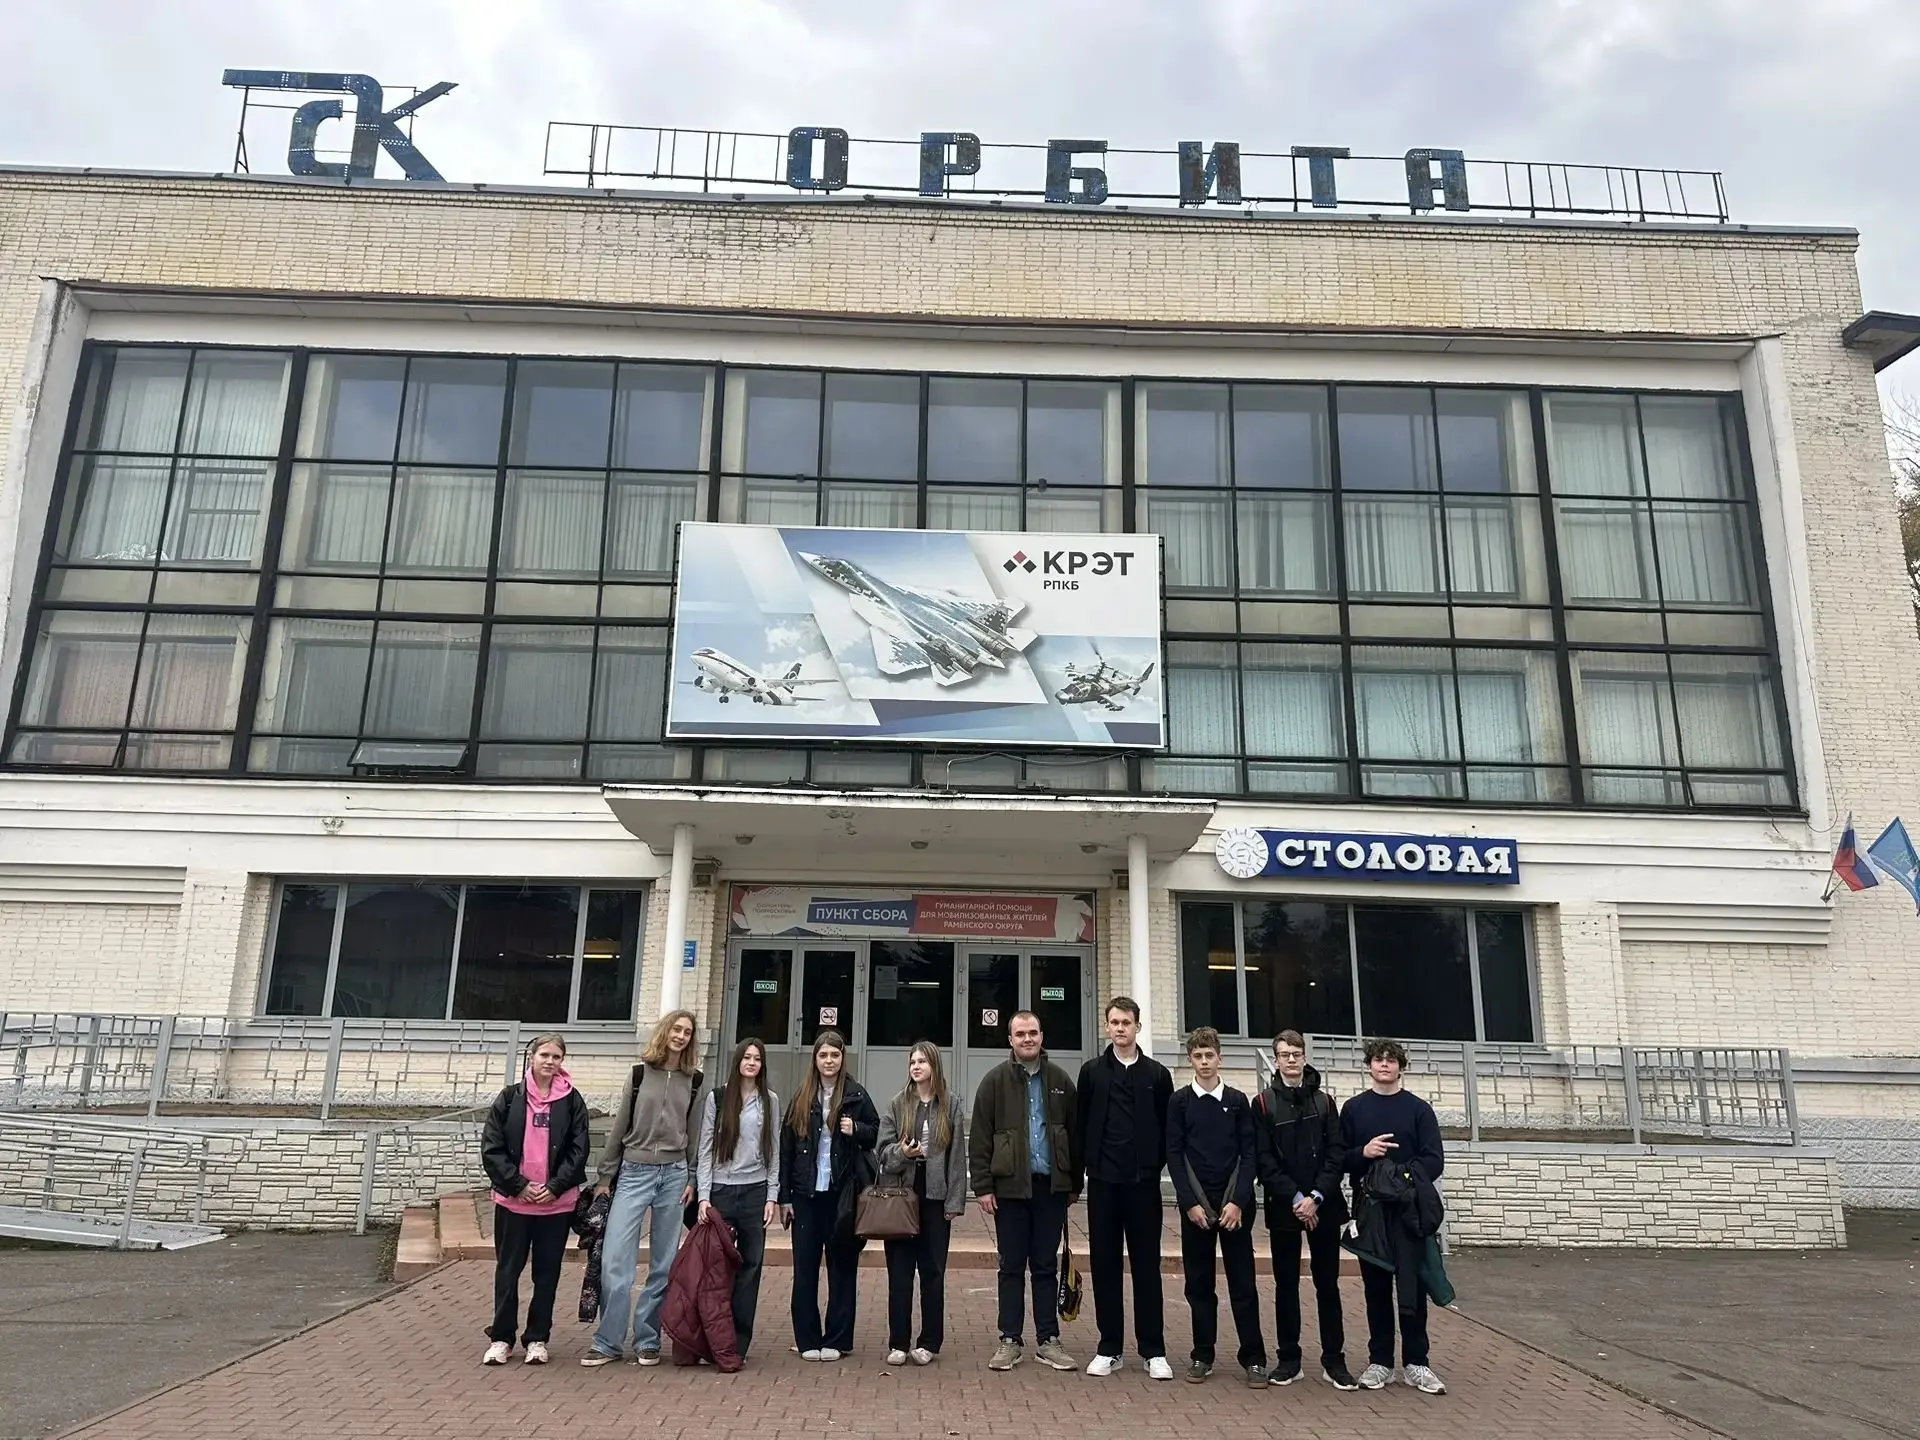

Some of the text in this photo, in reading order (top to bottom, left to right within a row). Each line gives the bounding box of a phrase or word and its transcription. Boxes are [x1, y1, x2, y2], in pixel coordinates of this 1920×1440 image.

[787, 126, 1470, 211] ОРБИТА
[1043, 551, 1135, 576] КРЭТ
[1043, 580, 1079, 590] РПКБ
[1275, 838, 1512, 875] СТОЛОВАЯ
[935, 902, 1032, 913] ГУМАНИТАРНОЙ ПОМОЩИ
[816, 908, 908, 921] ПУНКТ СБОРА
[920, 911, 1047, 921] ДЛЯ МОБИЛИЗОВАННЫХ ЖИТЕЛЕЙ
[943, 920, 1023, 931] РАМЕНСКОГО ОКРУГА
[755, 983, 775, 991] ВХОД
[1042, 989, 1063, 998] ВЫХОД
